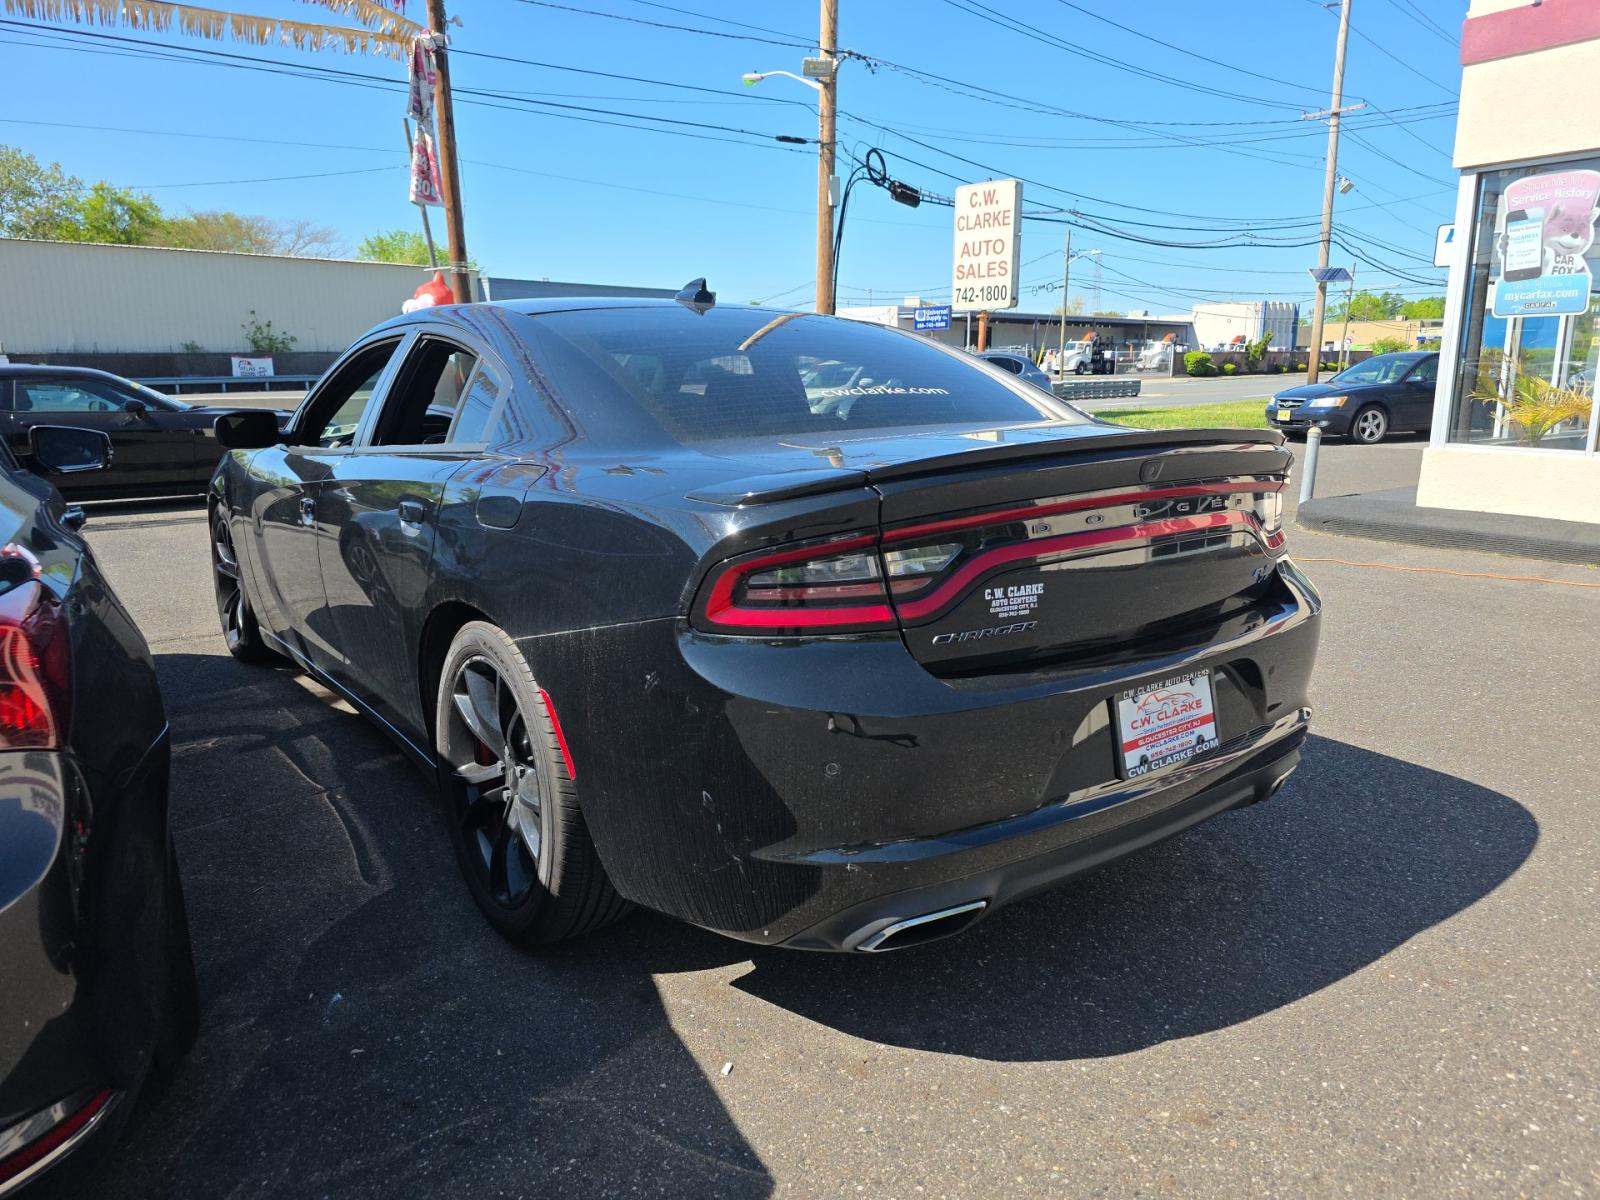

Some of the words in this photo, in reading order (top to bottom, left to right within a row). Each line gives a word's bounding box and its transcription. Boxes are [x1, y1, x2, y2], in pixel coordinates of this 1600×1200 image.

[969, 189, 999, 208] C.W.
[1512, 190, 1553, 207] Service
[1554, 187, 1593, 200] History
[957, 209, 1011, 232] CLARKE
[960, 238, 1005, 259] AUTO
[1554, 254, 1574, 265] CAR
[956, 260, 1008, 281] SALES
[1552, 265, 1574, 275] FOX
[955, 284, 1008, 303] 742-1800
[1504, 288, 1579, 303] mycarfax.com
[820, 385, 950, 398] cwclarke.com
[984, 587, 1005, 600] C.W.
[1007, 583, 1044, 598] CLARKE
[991, 598, 1008, 607] AUTO
[1009, 595, 1038, 605] CENTERS
[932, 620, 1038, 645] CHARGER
[1137, 682, 1162, 695] CLARKE
[1164, 676, 1181, 688] AUTO
[1131, 715, 1155, 730] C.W.
[1156, 699, 1203, 722] CLARKE
[1145, 730, 1195, 751] CWCLARKE.COM
[1128, 764, 1148, 778] CW
[1151, 738, 1219, 770] CLARKE.COM
